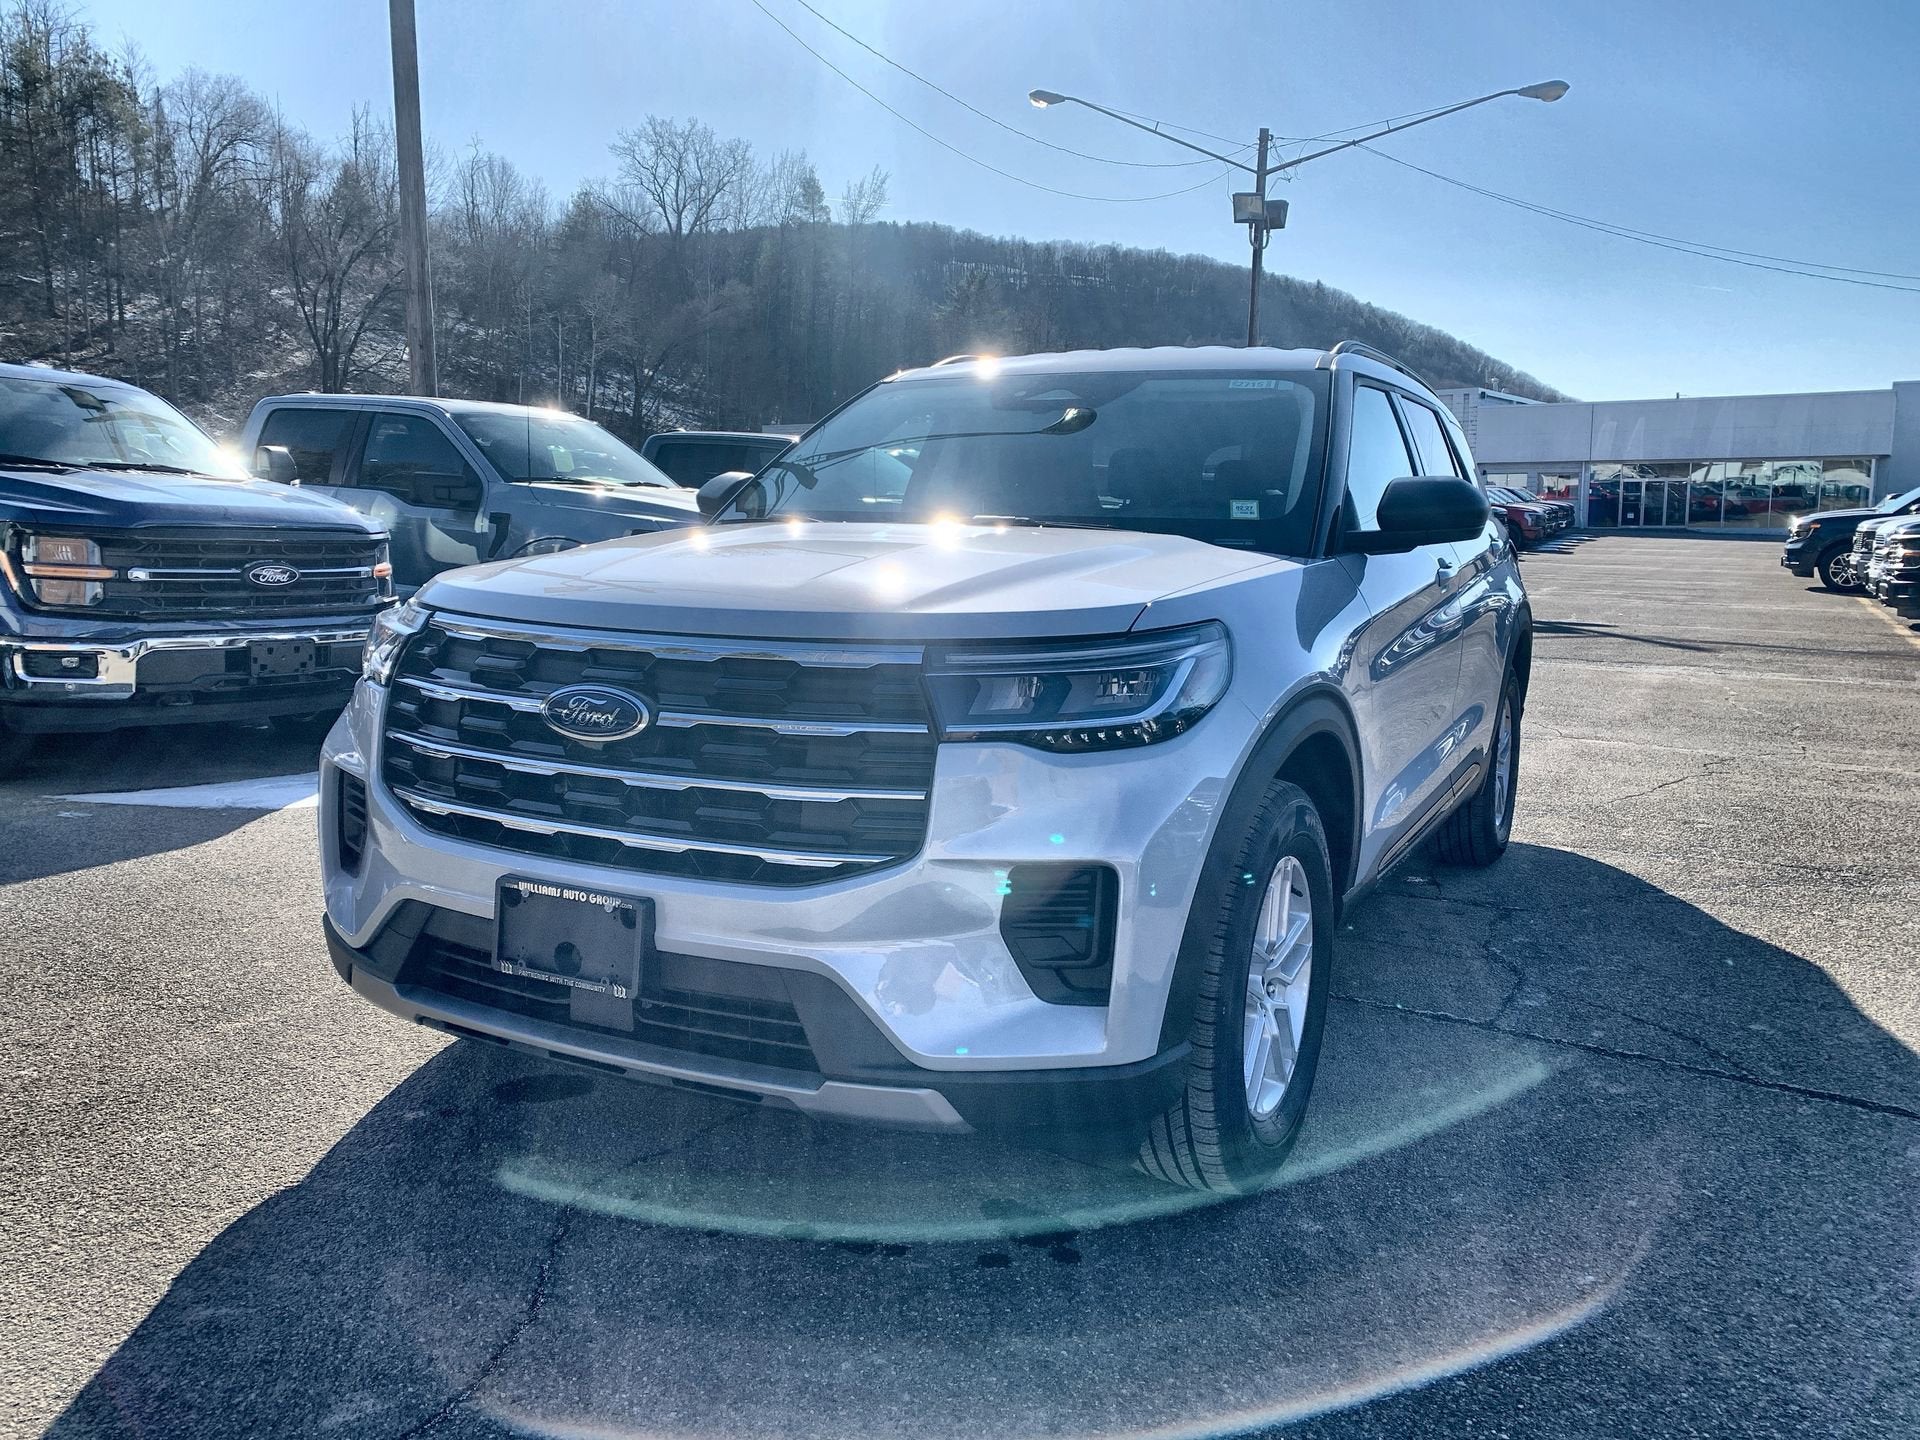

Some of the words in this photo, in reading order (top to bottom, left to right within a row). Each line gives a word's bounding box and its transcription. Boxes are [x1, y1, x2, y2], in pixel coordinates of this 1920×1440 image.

[259, 568, 290, 582] Ford
[554, 695, 621, 728] Ford
[562, 889, 587, 902] AUTO
[549, 976, 563, 985] WITH
